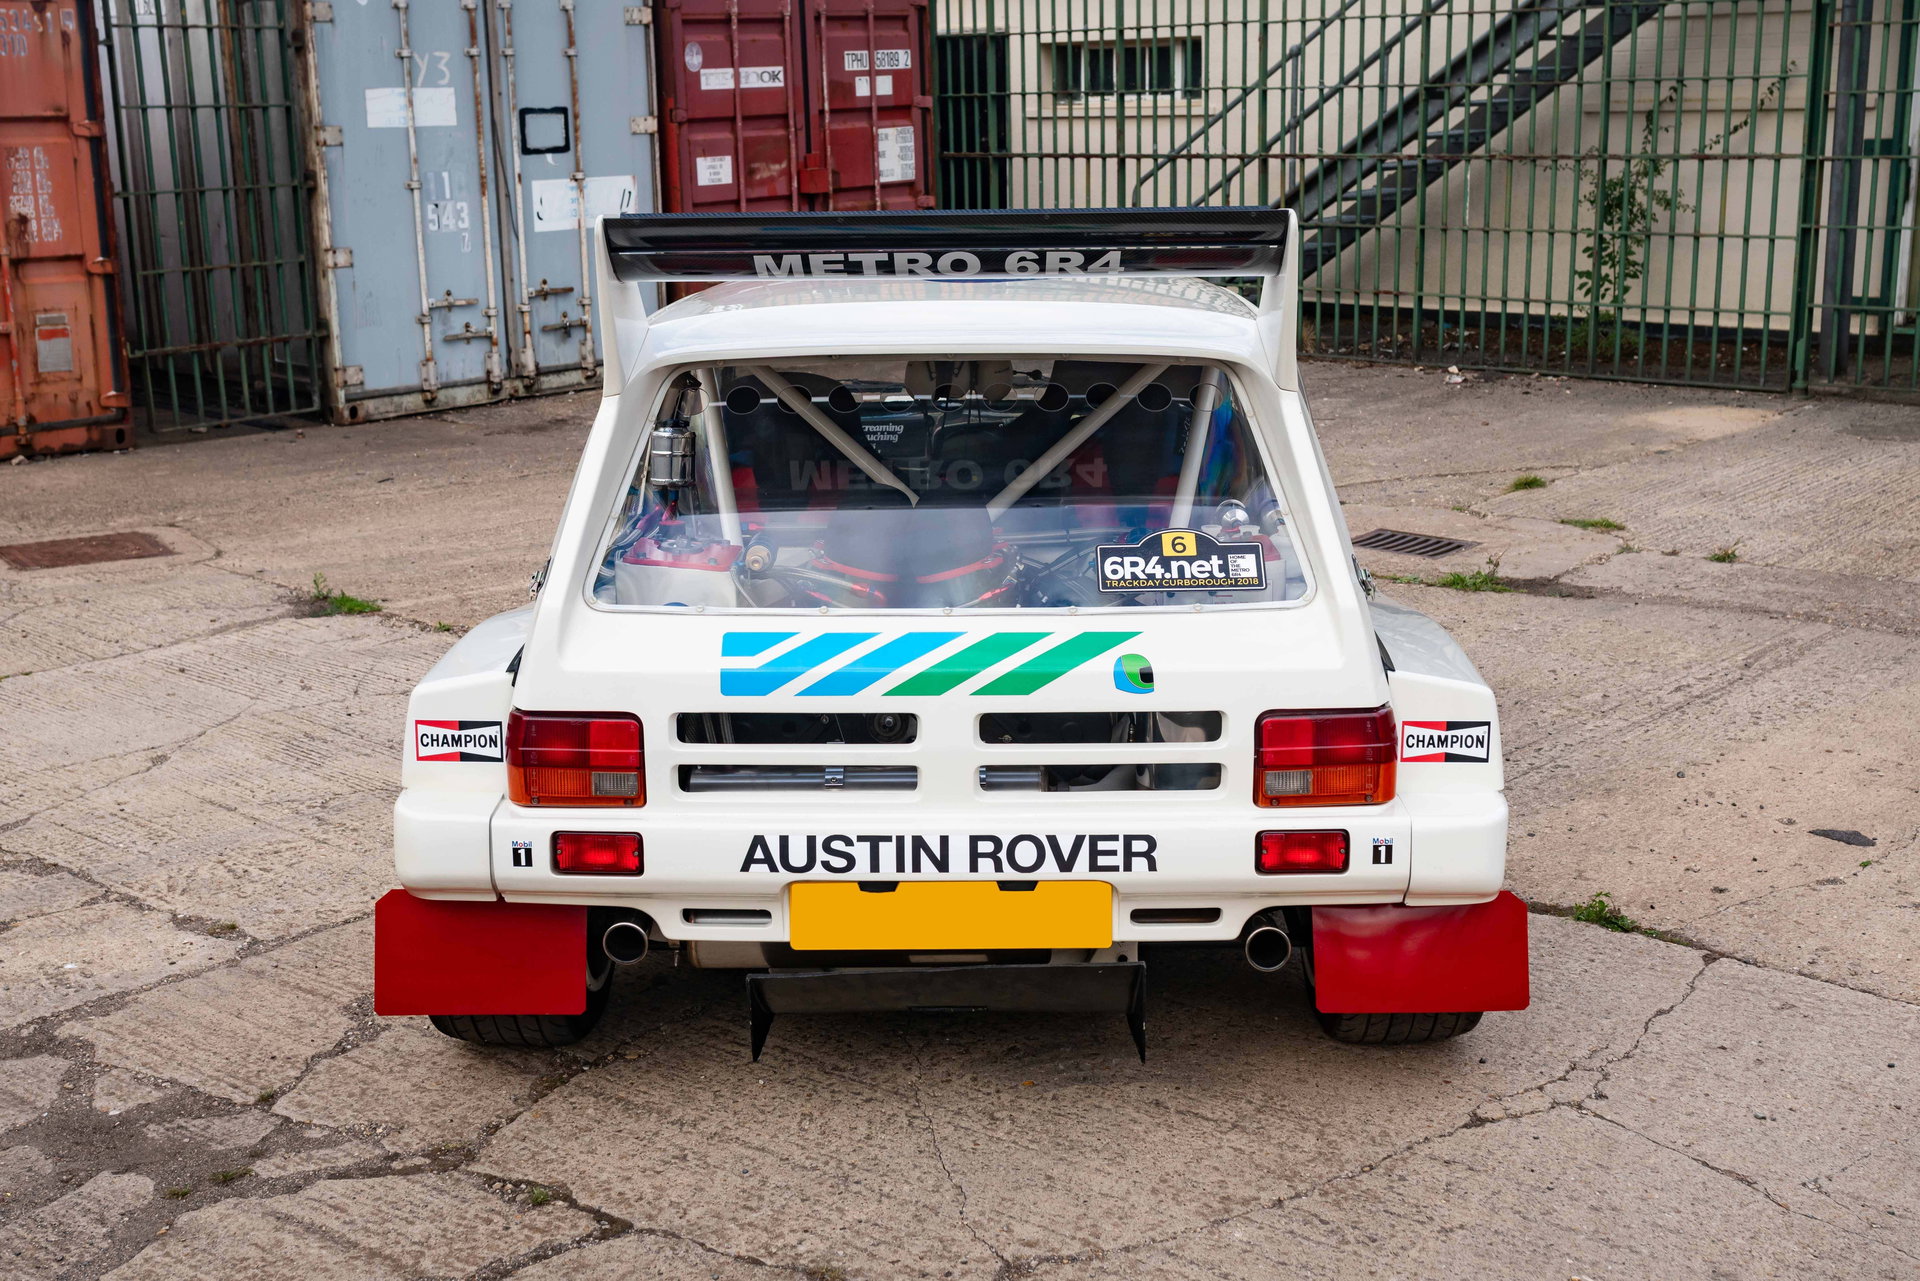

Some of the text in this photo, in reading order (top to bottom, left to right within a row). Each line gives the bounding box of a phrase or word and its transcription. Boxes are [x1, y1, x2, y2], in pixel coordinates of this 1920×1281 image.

[845, 52, 868, 69] TPHU
[753, 251, 1124, 278] METRO 6R4
[1171, 536, 1187, 554] 6
[1104, 555, 1226, 579] 6R4.net
[1106, 577, 1259, 588] TRACKDAY CURBOROUGH 2018
[420, 733, 498, 748] CHAMPION
[1406, 734, 1485, 748] CHAMPION
[512, 840, 533, 848] Mobil
[1373, 837, 1394, 845] Mobil
[518, 848, 526, 866] 1
[740, 834, 1158, 873] AUSTIN ROVER
[1378, 845, 1386, 863] 1
